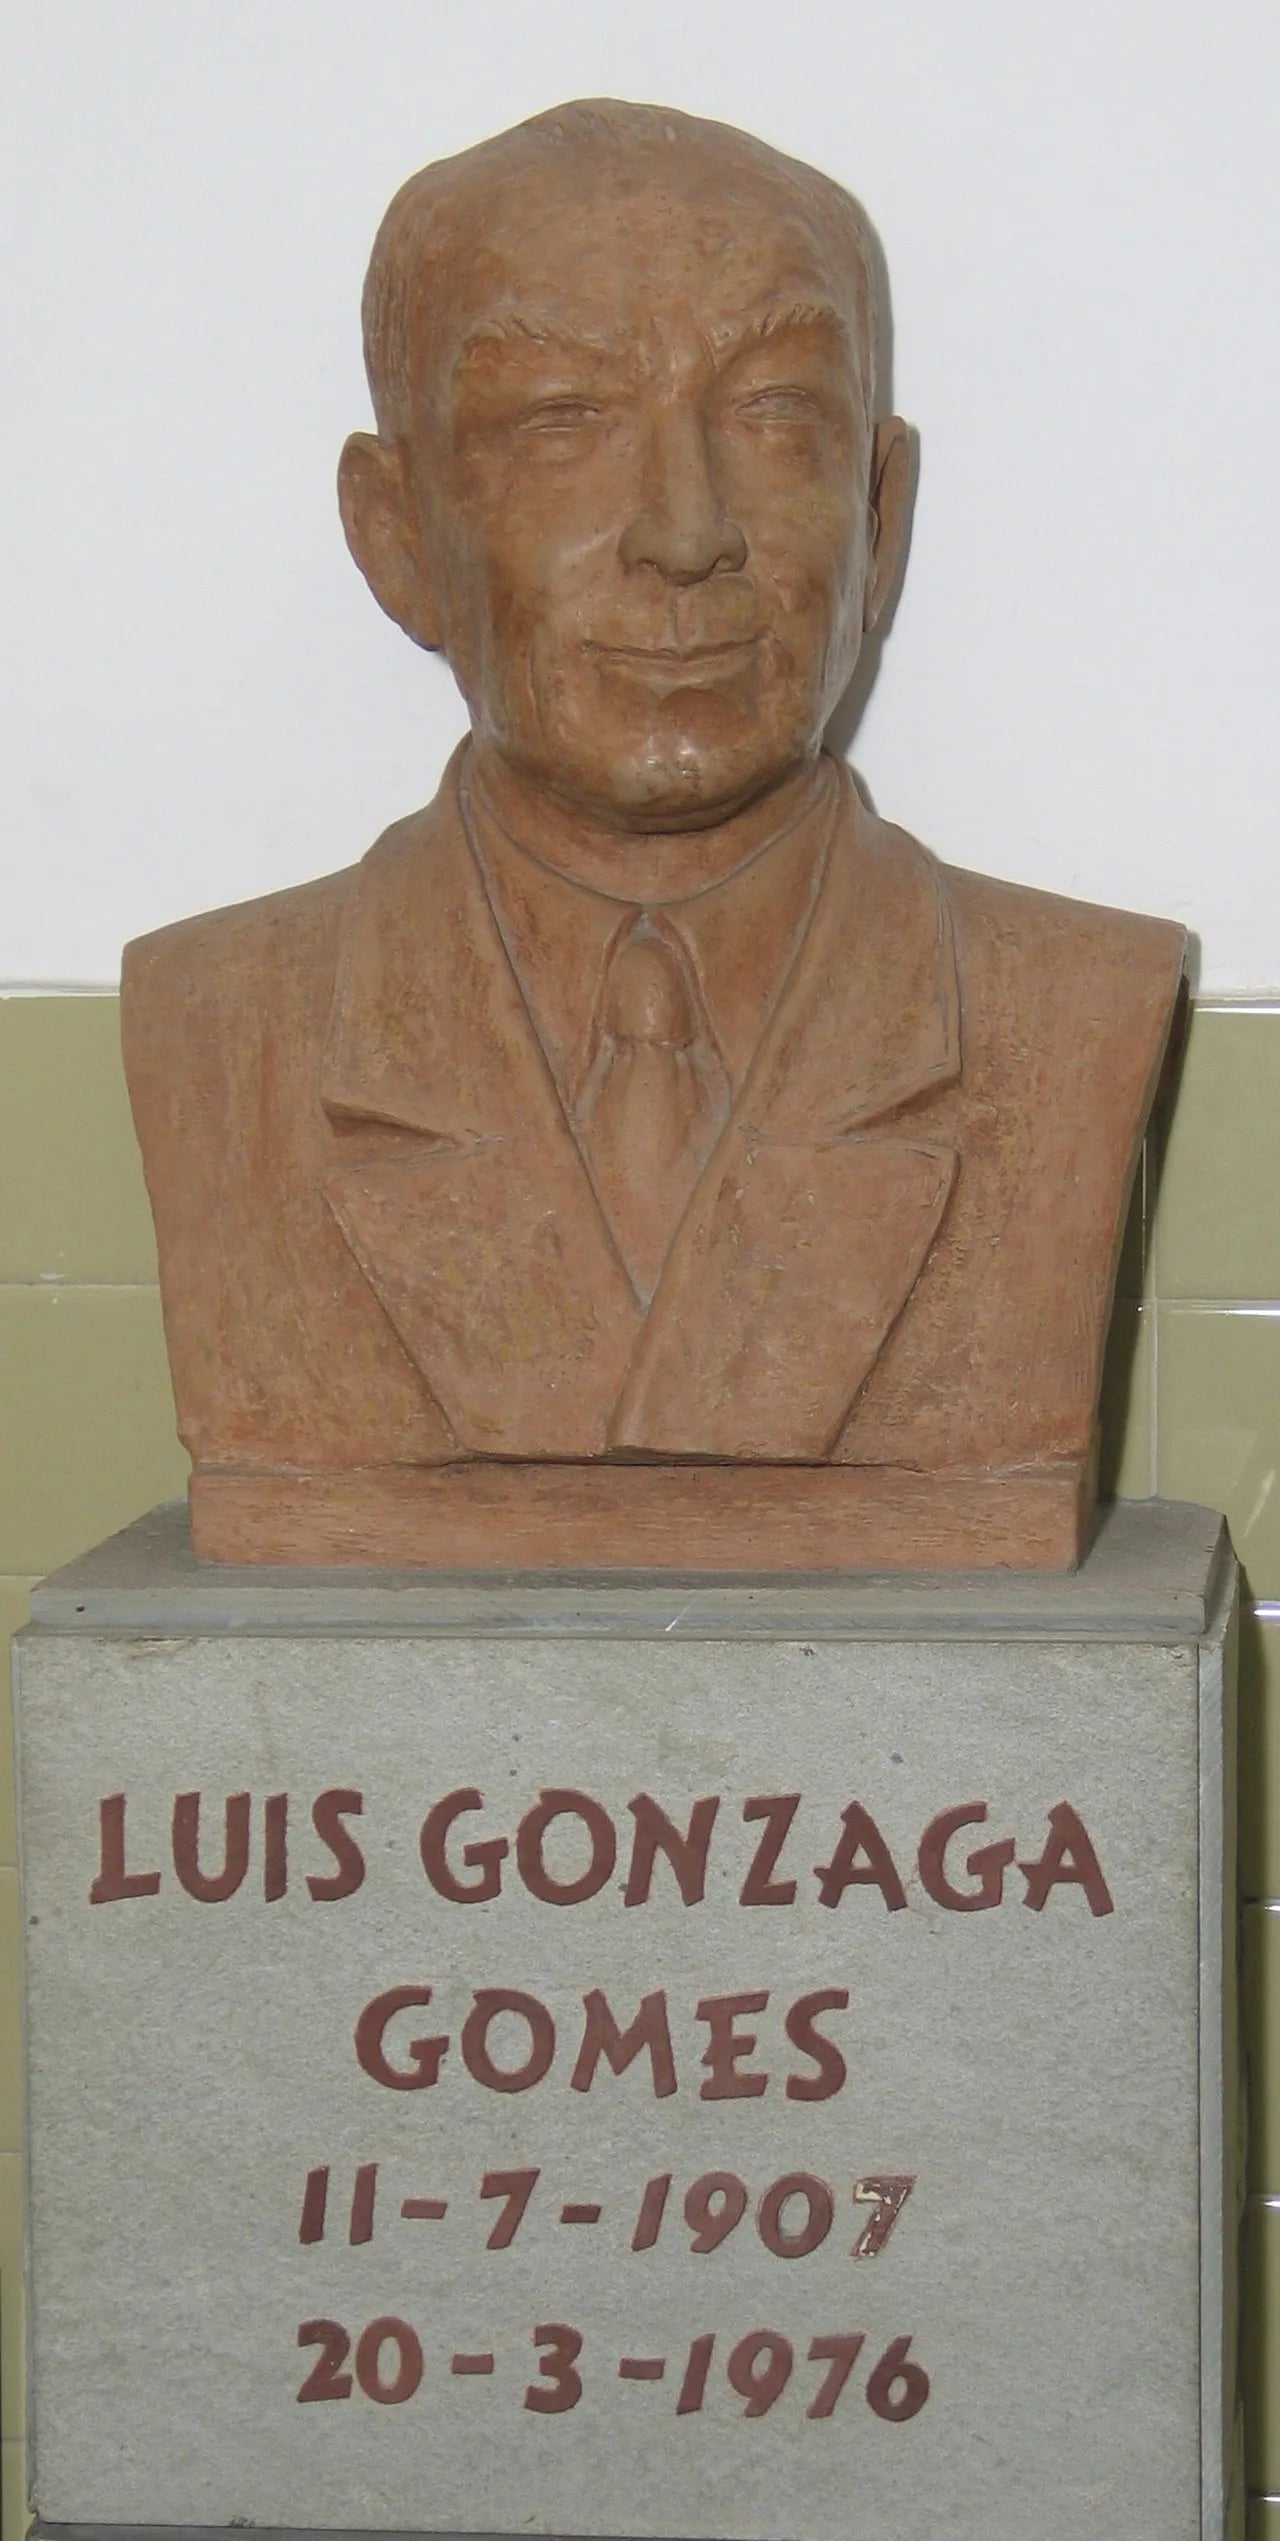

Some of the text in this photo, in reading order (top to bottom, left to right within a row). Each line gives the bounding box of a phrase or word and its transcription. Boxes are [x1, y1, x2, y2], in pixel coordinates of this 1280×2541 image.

[91, 1788, 1114, 1916] LUIS GONZAGA
[355, 1986, 849, 2102] GOMES
